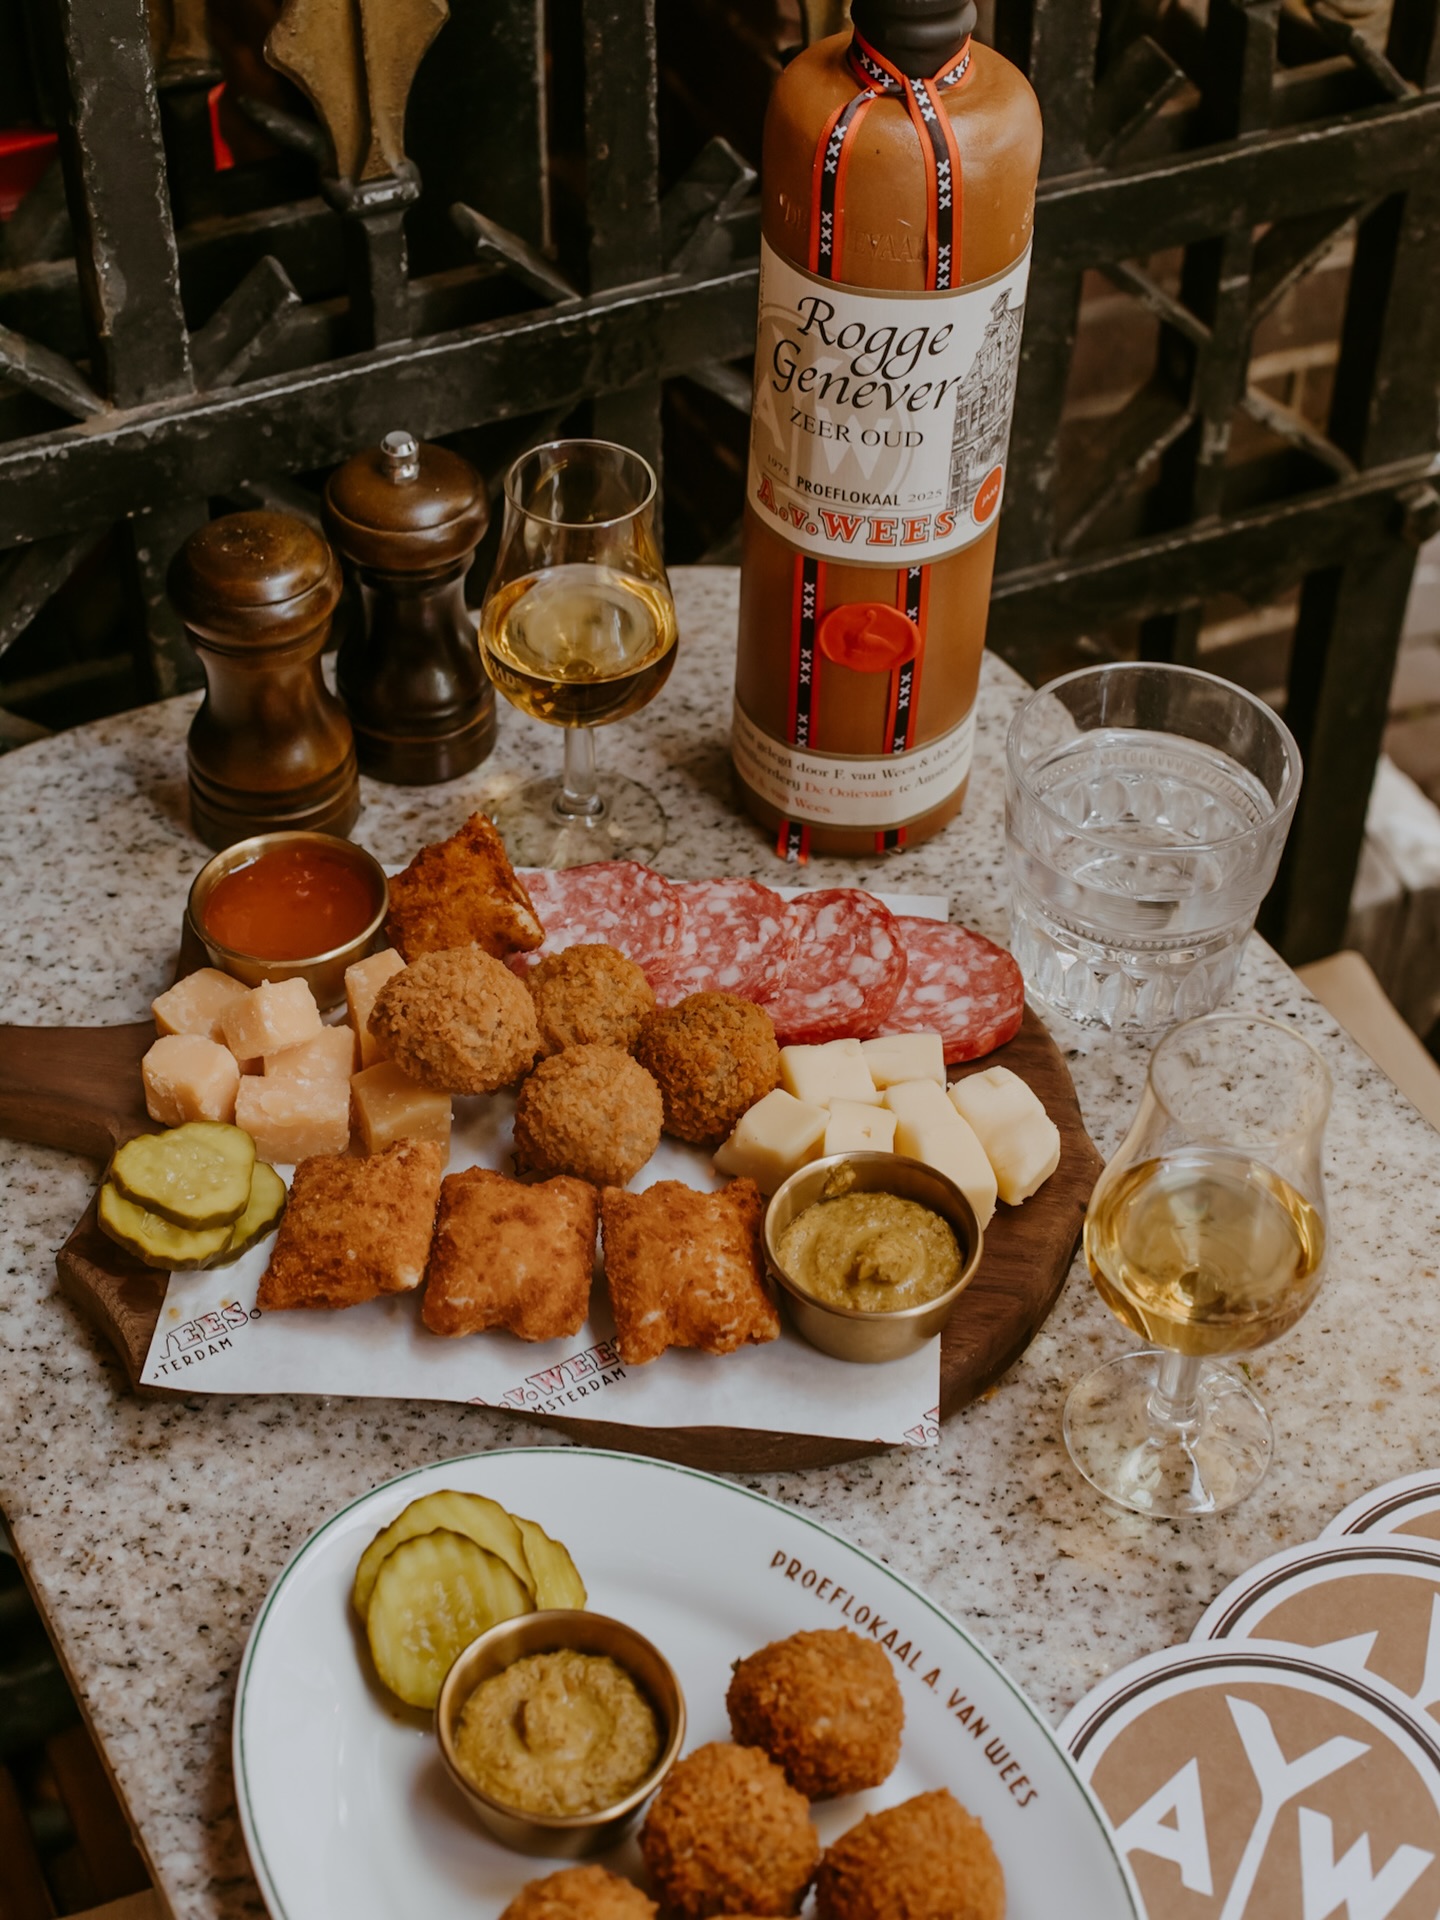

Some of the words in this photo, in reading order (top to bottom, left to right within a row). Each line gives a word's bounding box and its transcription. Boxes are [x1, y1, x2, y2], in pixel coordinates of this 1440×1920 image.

[797, 296, 954, 380] Rogge
[772, 339, 962, 412] Genever
[790, 406, 852, 443] ZEER
[861, 429, 924, 448] OUD
[797, 475, 901, 506] PROEFLOKAAL
[907, 488, 943, 503] 2025
[796, 762, 829, 779] door
[851, 772, 876, 781] van
[882, 764, 916, 779] Wees
[153, 1338, 233, 1379] TERDAM
[769, 1549, 923, 1672] PROEFLOKAAL
[921, 1667, 941, 1695] A.
[946, 1687, 991, 1740] VAN
[983, 1737, 1039, 1808] WEES
